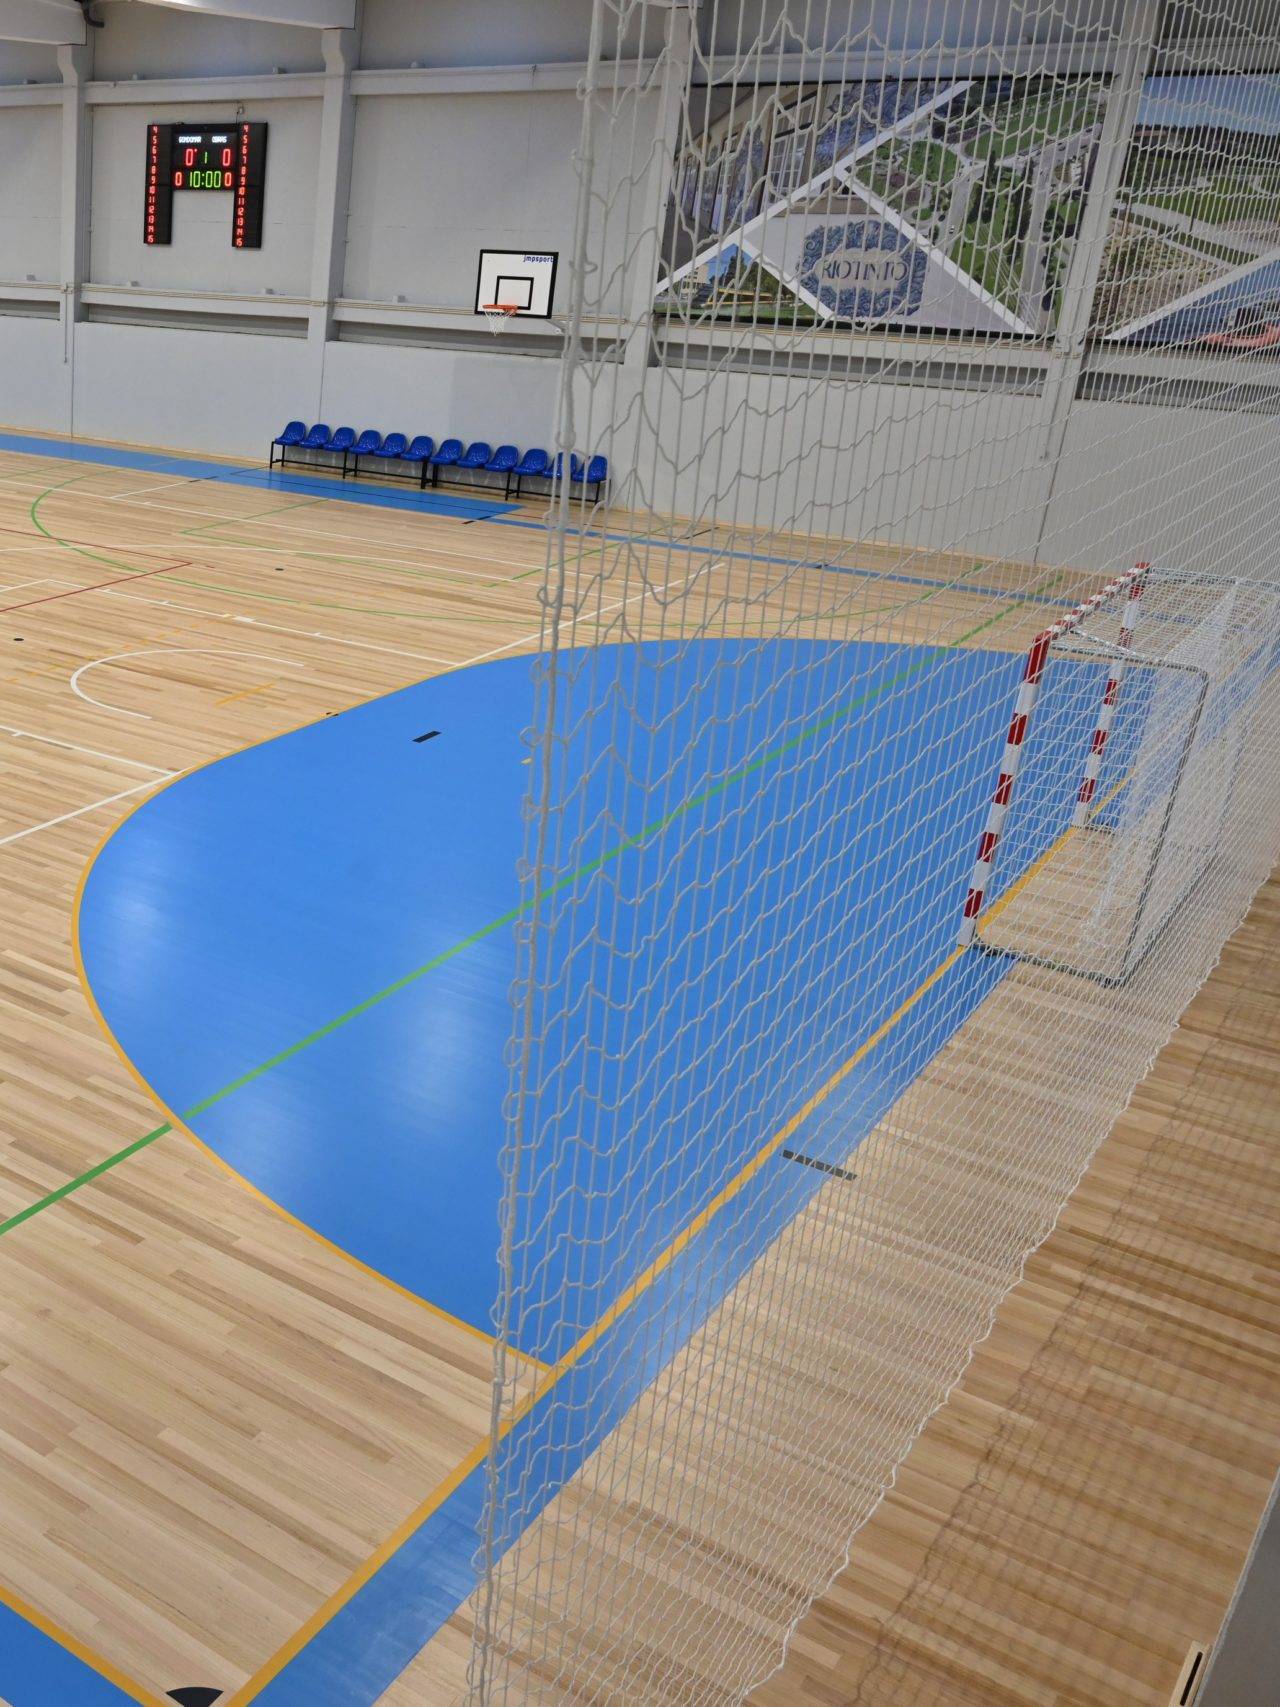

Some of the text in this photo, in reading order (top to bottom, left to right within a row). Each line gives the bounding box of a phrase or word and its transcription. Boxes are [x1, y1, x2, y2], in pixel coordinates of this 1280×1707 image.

[186, 149, 230, 166] 0 1 0
[175, 171, 232, 188] 0 10:00 0
[522, 255, 554, 263] jmpsport
